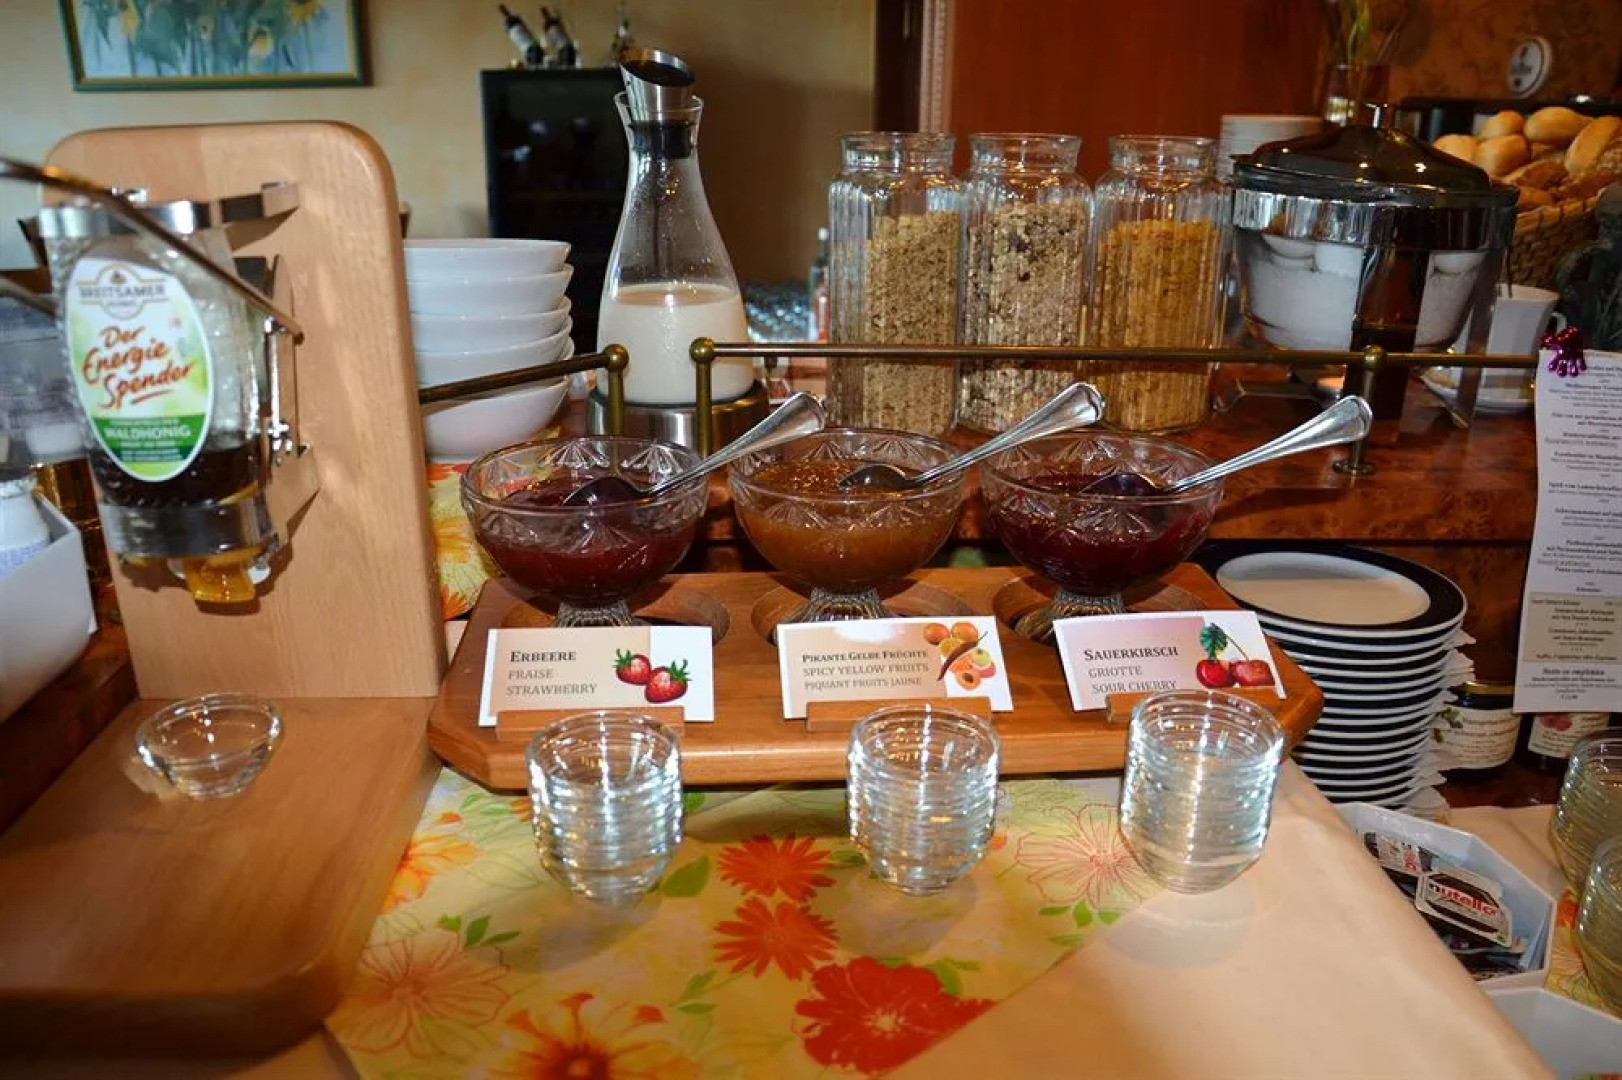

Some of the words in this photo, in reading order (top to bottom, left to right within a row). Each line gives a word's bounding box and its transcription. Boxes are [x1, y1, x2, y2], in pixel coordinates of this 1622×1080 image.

[99, 326, 145, 348] Der
[83, 338, 170, 386] Energie
[98, 361, 197, 411] Spender
[1083, 646, 1179, 661] SAUERKIRSCH
[508, 668, 554, 680] FRAISE
[802, 666, 835, 677] SPICY
[837, 664, 886, 675] YELLOW
[888, 662, 929, 673] FRUITS
[1088, 666, 1142, 678] GRIOTTE
[506, 683, 597, 697] STRAWBERRY
[804, 680, 849, 691] PIQUANT
[852, 678, 889, 688] FRUITS
[1092, 681, 1127, 694] SOUR
[1128, 679, 1177, 692] CHERRY
[1429, 883, 1499, 917] nutella
